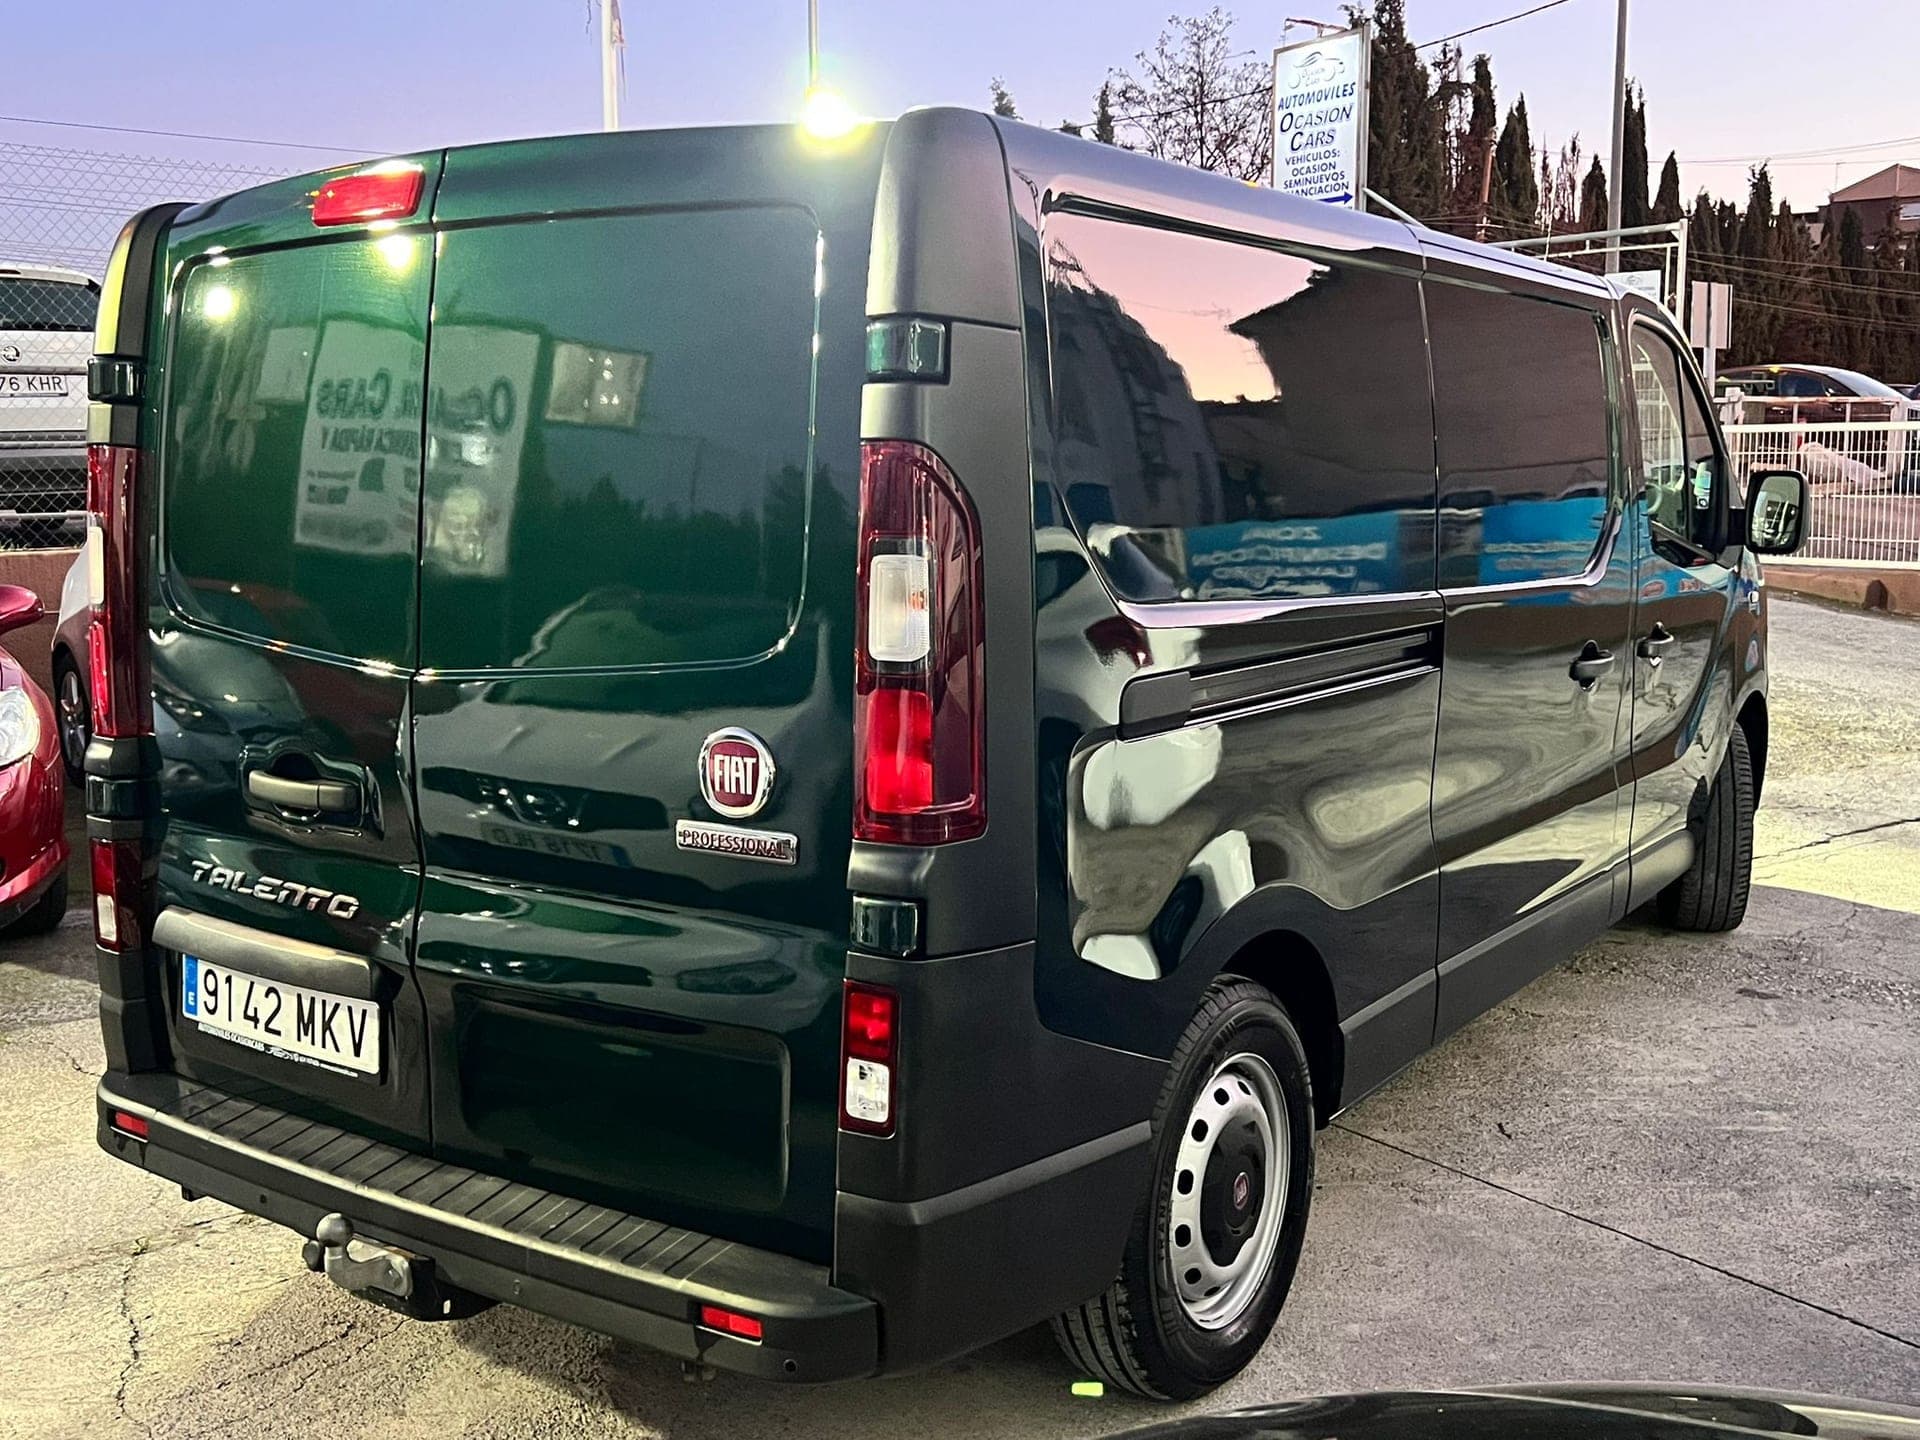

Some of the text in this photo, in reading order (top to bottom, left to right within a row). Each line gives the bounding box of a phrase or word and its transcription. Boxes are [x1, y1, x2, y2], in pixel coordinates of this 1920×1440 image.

[1278, 82, 1356, 111] AUTOMOVILES
[1280, 104, 1353, 132] OCASION
[1290, 129, 1336, 151] CARS
[1284, 171, 1345, 189] SEMINUEVOS
[1292, 161, 1337, 177] OCASION
[27, 376, 63, 391] KHR
[714, 754, 757, 795] FIAT
[682, 829, 787, 858] PROFESSIONAL
[192, 860, 360, 919] TALENTO
[188, 992, 195, 1005] E
[203, 969, 282, 1037] 9142
[297, 993, 367, 1058] MKV
